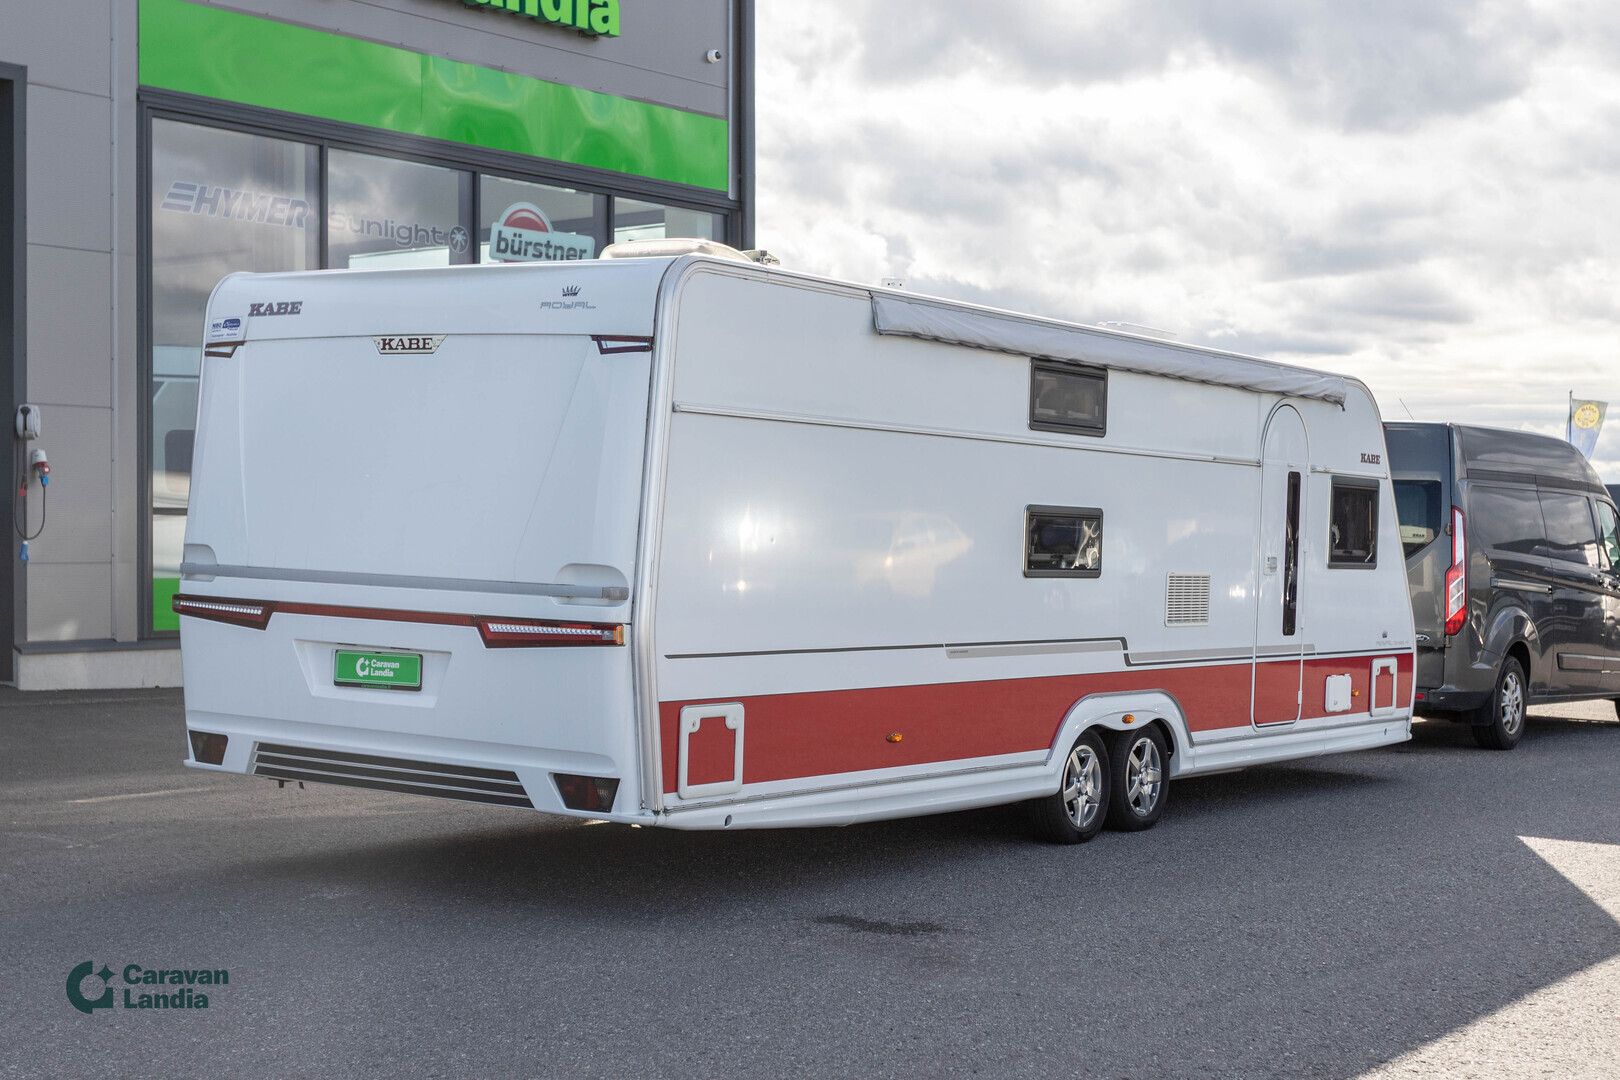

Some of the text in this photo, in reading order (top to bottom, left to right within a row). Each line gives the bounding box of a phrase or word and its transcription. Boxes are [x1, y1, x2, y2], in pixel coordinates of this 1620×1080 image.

[193, 183, 310, 229] HYMER
[328, 211, 445, 248] Sunlight
[495, 230, 588, 261] bürstner
[248, 301, 303, 317] KABE
[380, 337, 434, 351] KABE
[1360, 452, 1381, 465] KABE
[371, 659, 399, 668] Caravan
[371, 669, 393, 677] Landia
